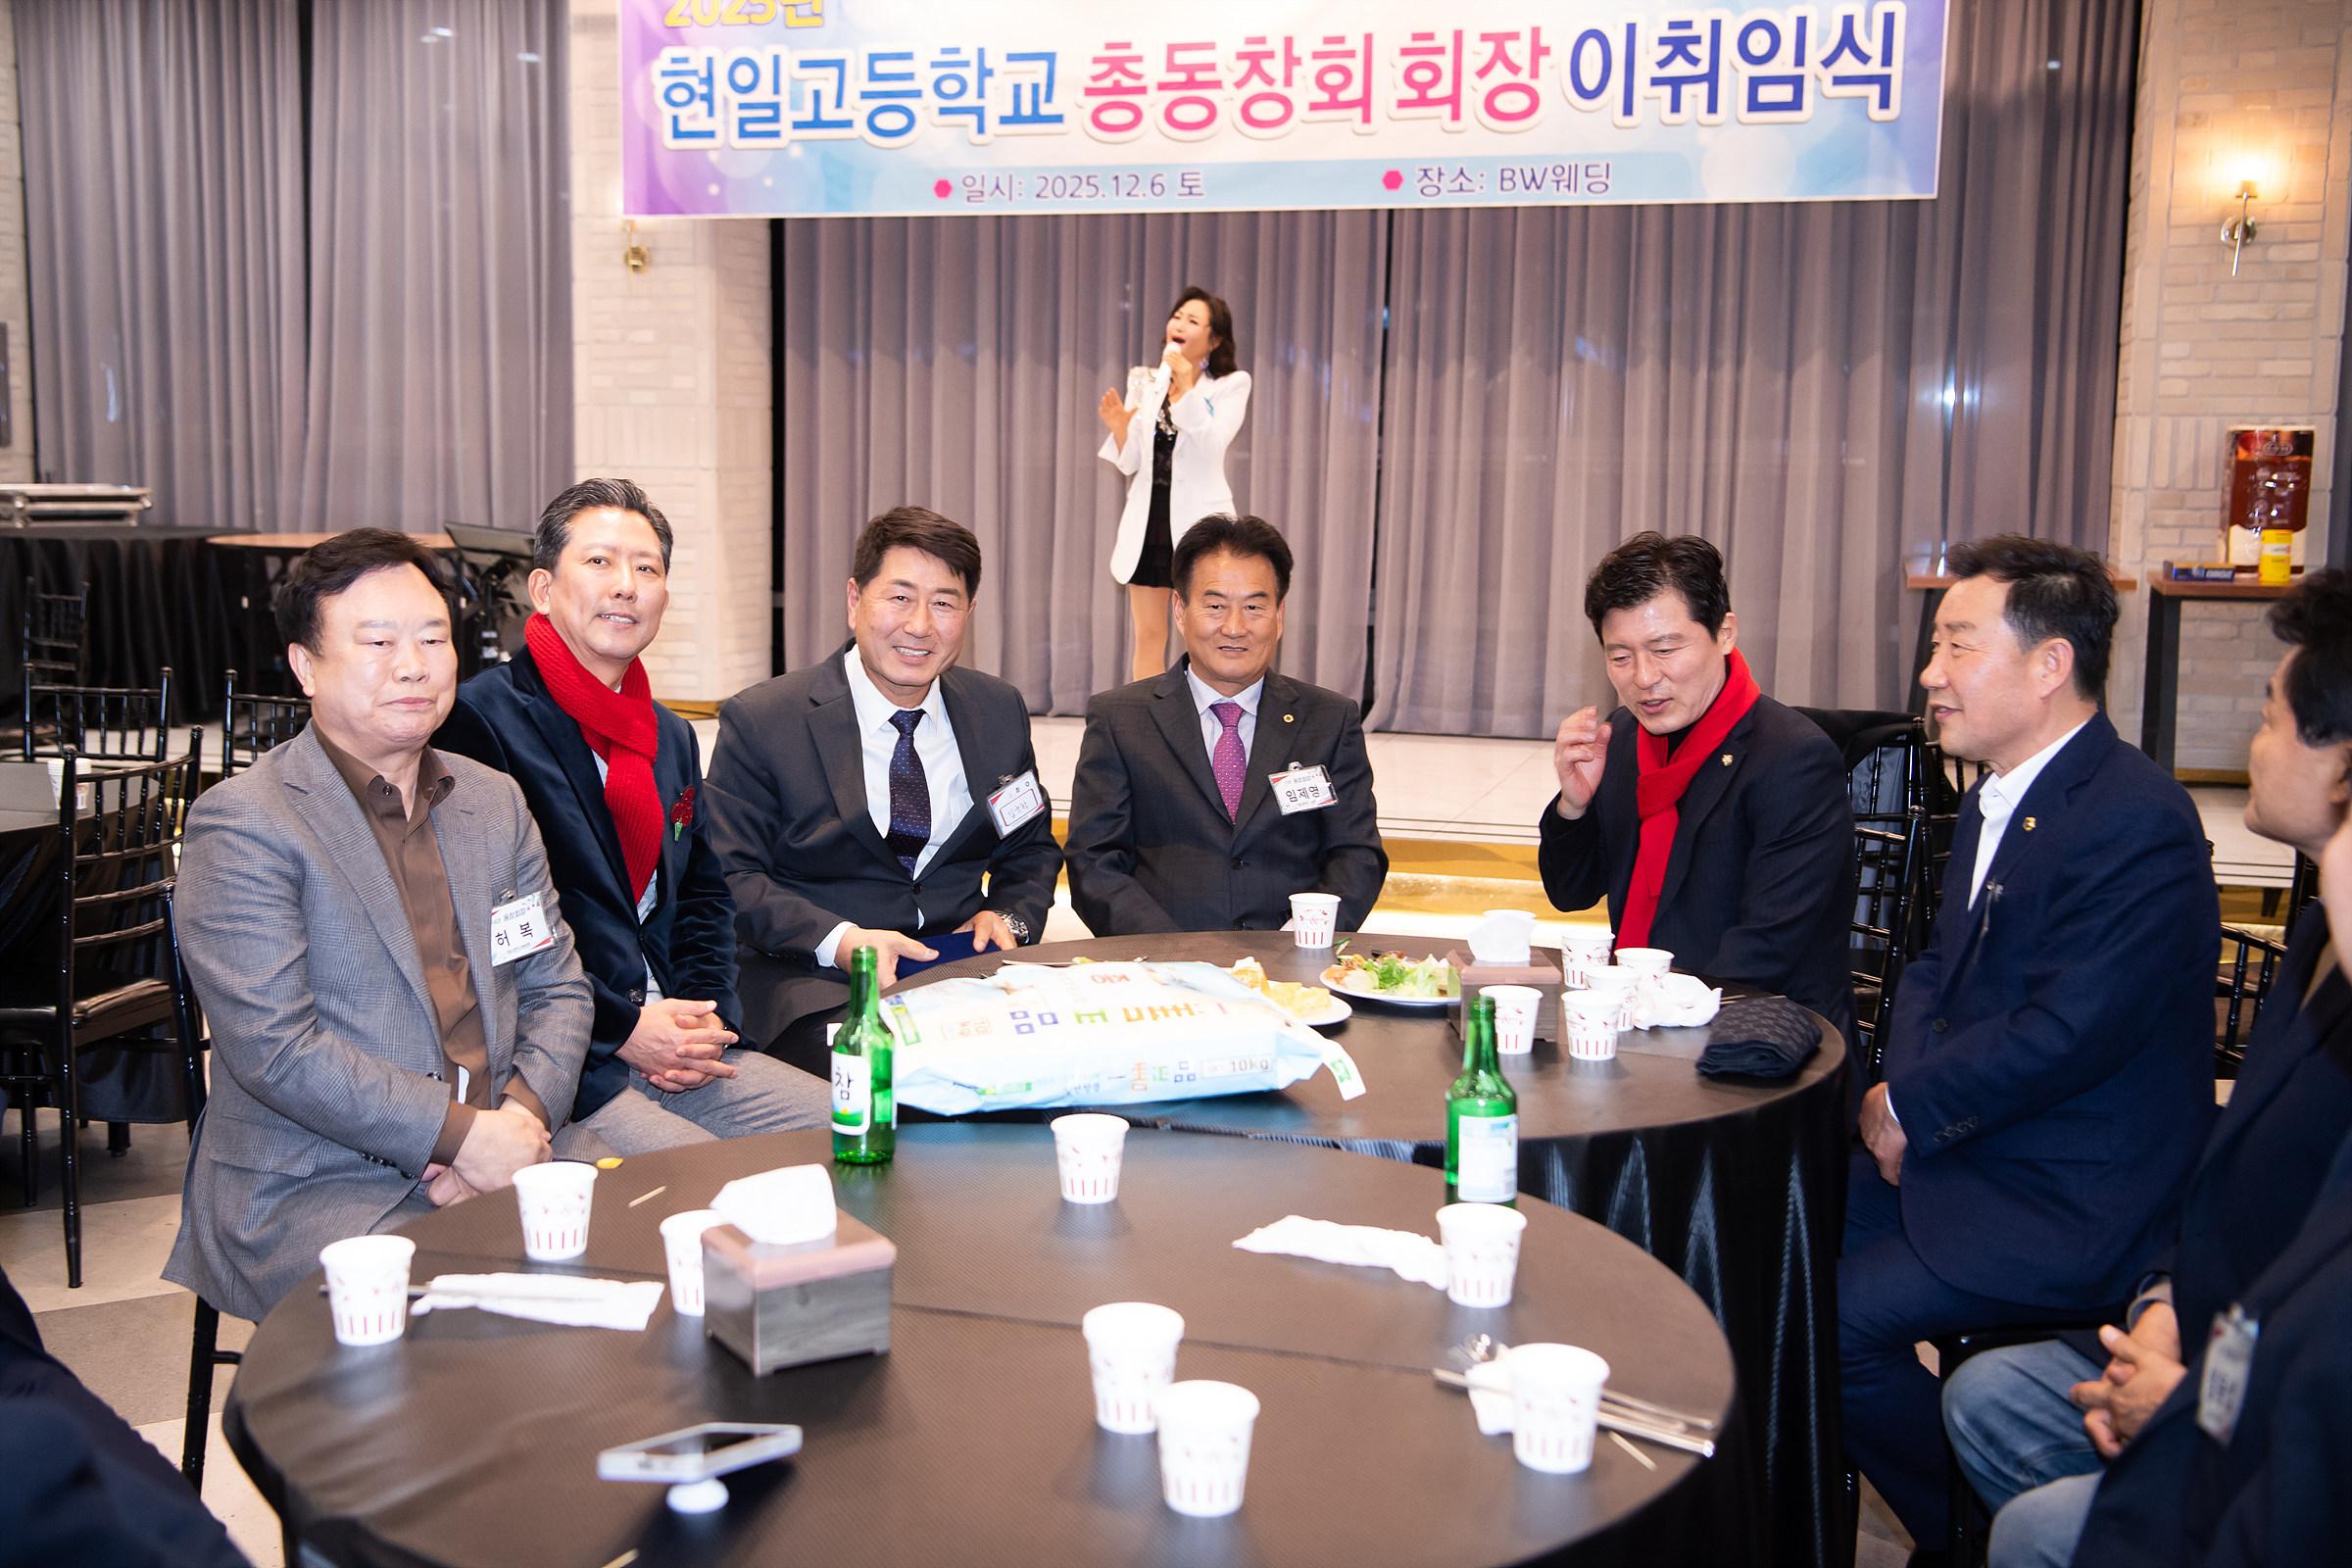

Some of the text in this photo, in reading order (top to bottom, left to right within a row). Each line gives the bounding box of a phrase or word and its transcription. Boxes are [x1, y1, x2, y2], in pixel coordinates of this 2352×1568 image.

[659, 11, 1896, 140] 현일고등학교 총동창회 회장 이취임식
[961, 171, 1204, 203] 일시: 2025.12.6 토
[1416, 163, 1611, 198] 장소: BW웨딩
[1230, 1058, 1271, 1073] 10kg
[835, 1066, 855, 1101] 참
